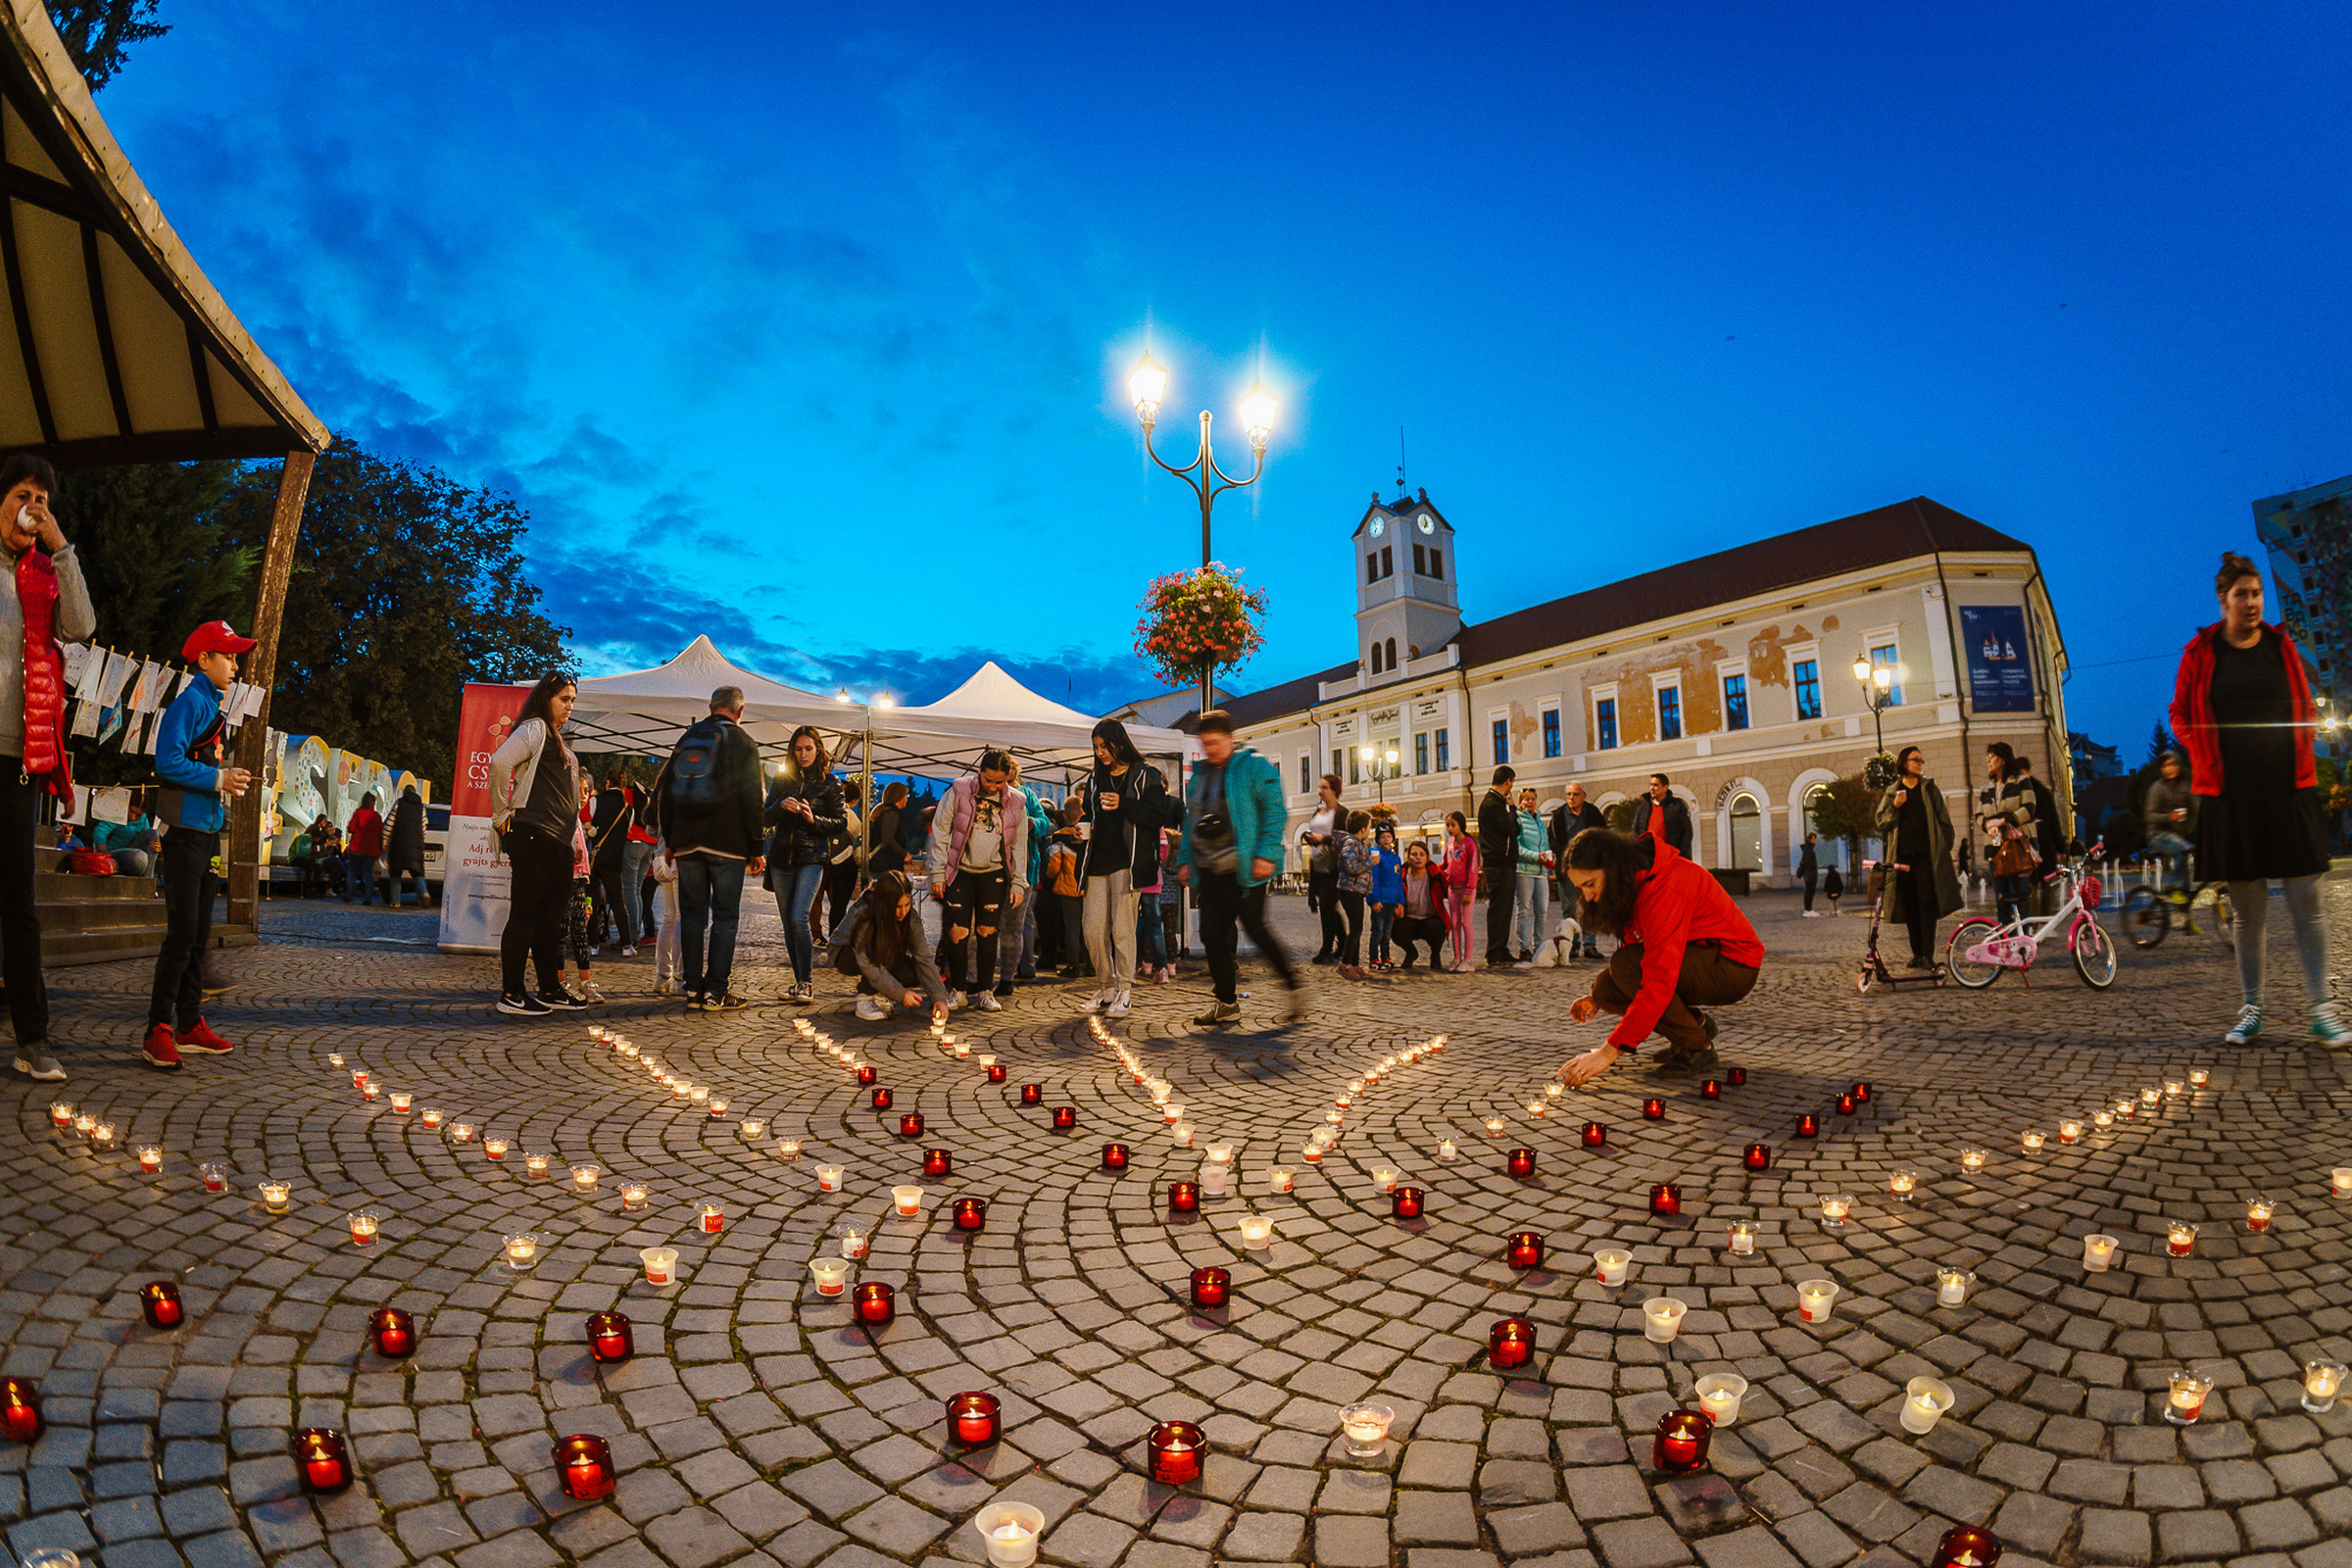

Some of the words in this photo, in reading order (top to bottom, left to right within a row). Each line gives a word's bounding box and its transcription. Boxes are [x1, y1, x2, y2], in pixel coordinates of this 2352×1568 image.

[470, 751, 494, 763] EGY
[468, 844, 484, 856] Adj
[463, 857, 488, 867] gyújts
